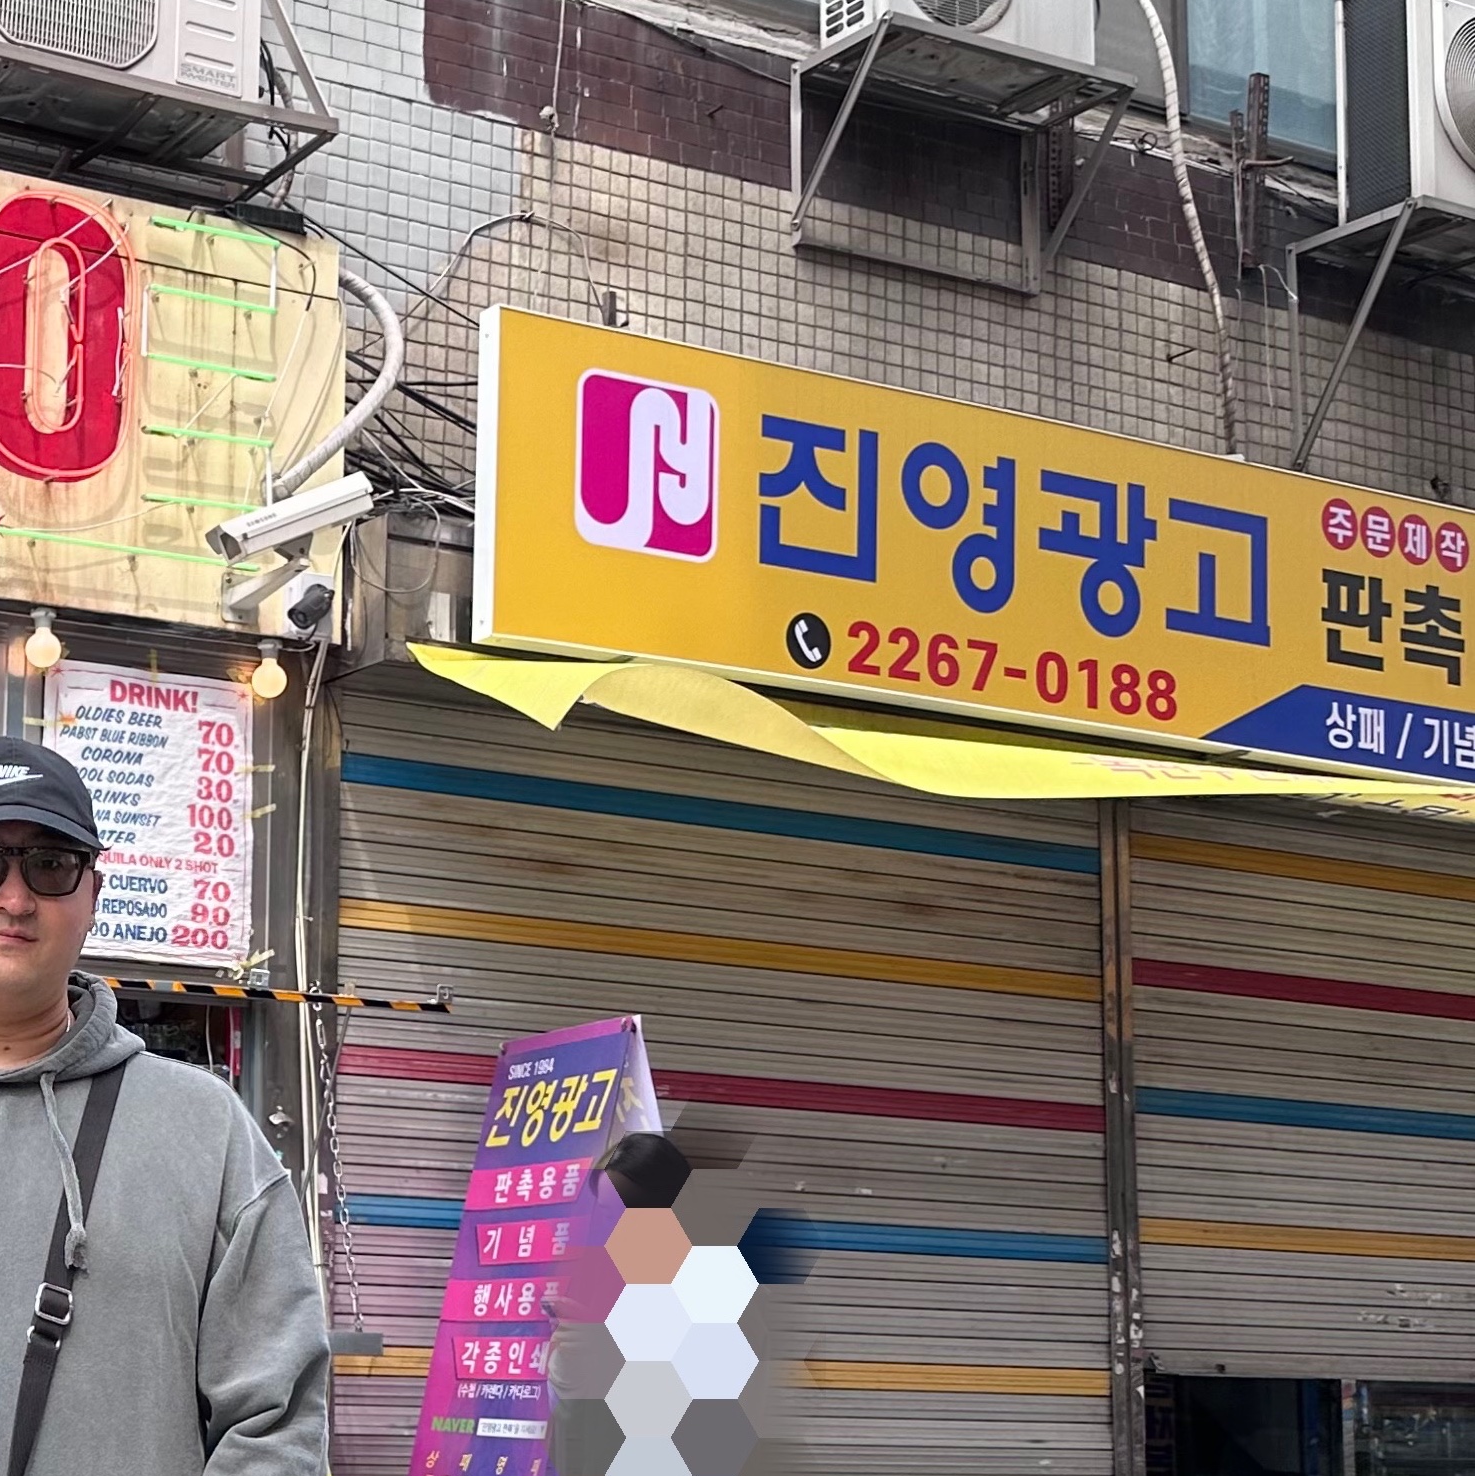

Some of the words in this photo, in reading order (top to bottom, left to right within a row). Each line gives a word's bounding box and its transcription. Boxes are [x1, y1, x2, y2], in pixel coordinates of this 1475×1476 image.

[180, 63, 237, 83] SMART
[180, 71, 236, 89] INVERTER
[758, 411, 1271, 648] 진영광고
[1327, 506, 1466, 568] 주문제작
[1321, 568, 1466, 686] 판촉
[847, 618, 1178, 722] 2267-0188
[109, 679, 199, 713] DRINK!
[75, 706, 126, 724] OLDIES
[128, 711, 163, 729] BEER
[1325, 701, 1385, 755] 상패
[60, 723, 98, 742] PABST
[98, 728, 126, 744] BLUE
[128, 732, 169, 748] RIBBON
[81, 746, 144, 766] CORONA
[106, 771, 155, 788] SODAS
[114, 811, 161, 827] SUNSET
[97, 830, 137, 845] ATER
[139, 855, 173, 870] ONLY
[174, 859, 183, 870] 2
[184, 859, 218, 874] SHOT
[109, 874, 168, 895] CUERVO
[102, 898, 167, 918] REPOSADO
[113, 923, 168, 943] ANEJO
[508, 1060, 533, 1082] SINCE
[485, 1068, 618, 1149] 진영광고
[493, 1163, 582, 1204] 판촉용품
[483, 1222, 571, 1260] 기념품
[461, 1334, 550, 1376] 각종인쇄
[430, 1416, 476, 1434] NAVER
